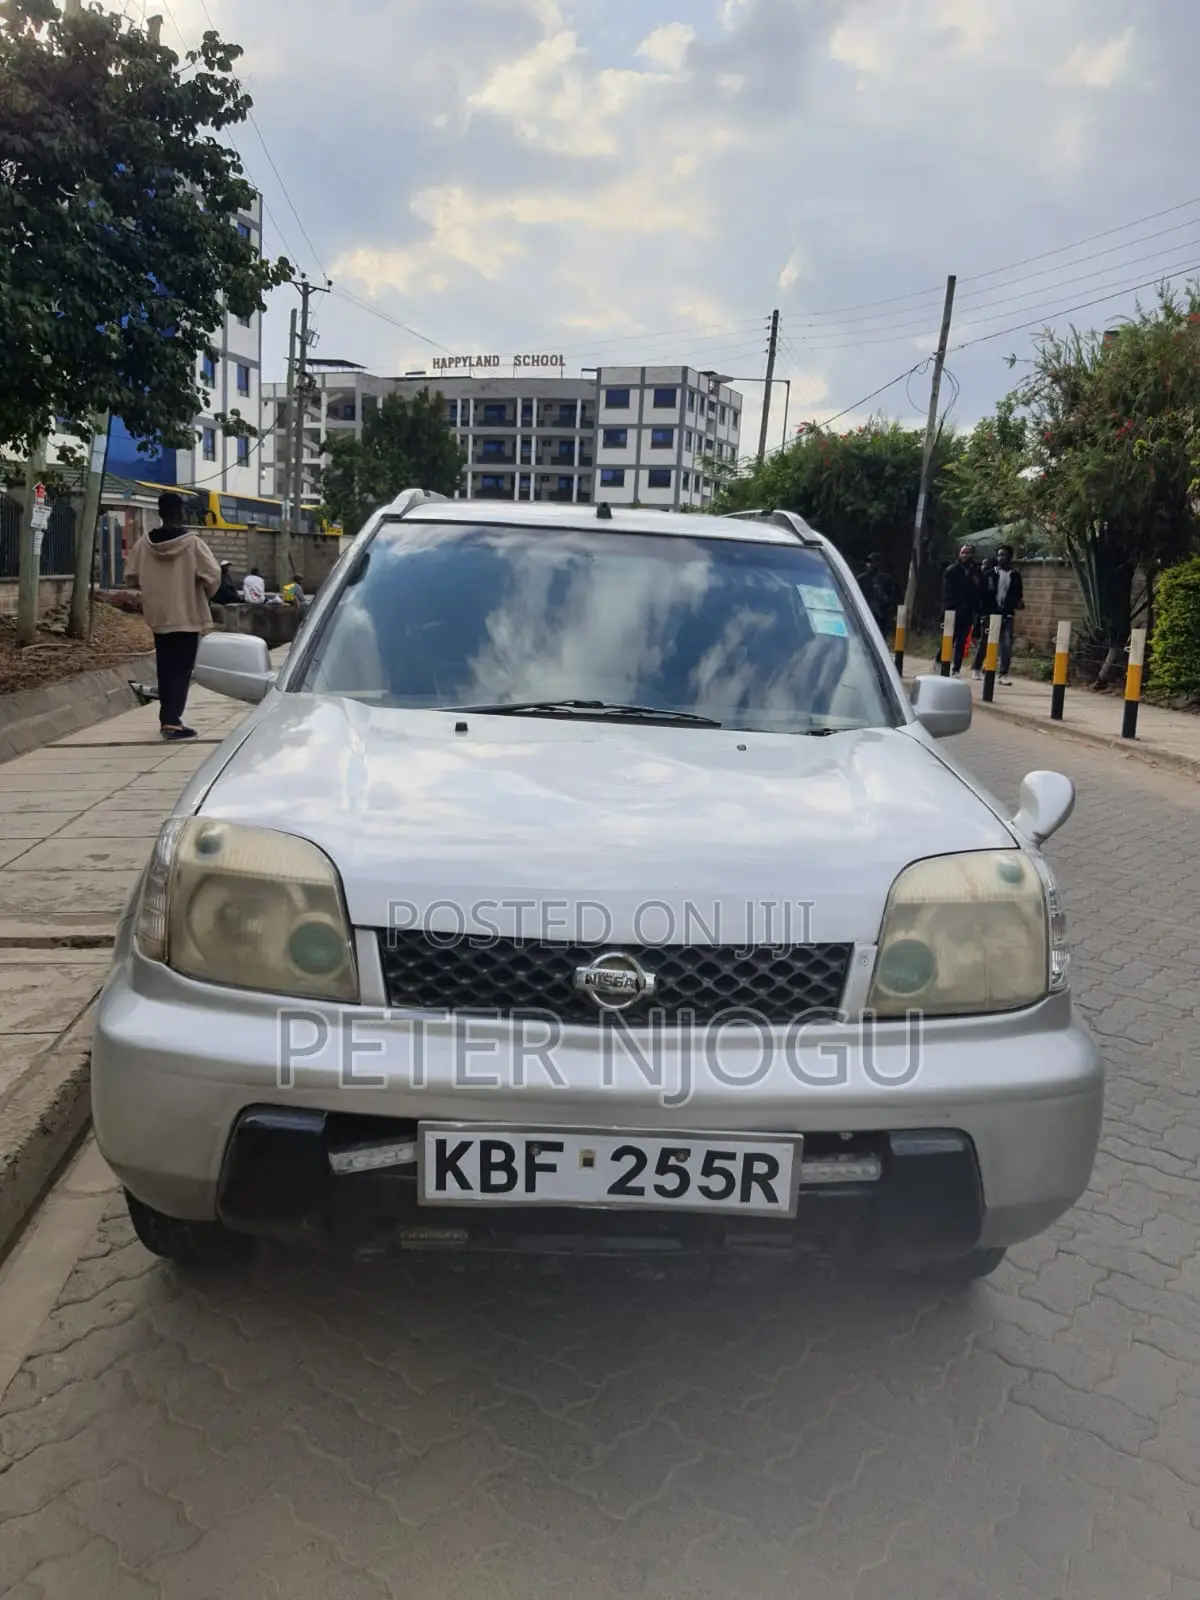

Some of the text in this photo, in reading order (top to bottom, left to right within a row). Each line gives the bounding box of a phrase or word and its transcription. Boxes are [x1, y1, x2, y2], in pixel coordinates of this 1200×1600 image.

[433, 354, 566, 369] HAPPYLAND SCHOOL
[435, 1138, 780, 1204] KBF 255R
